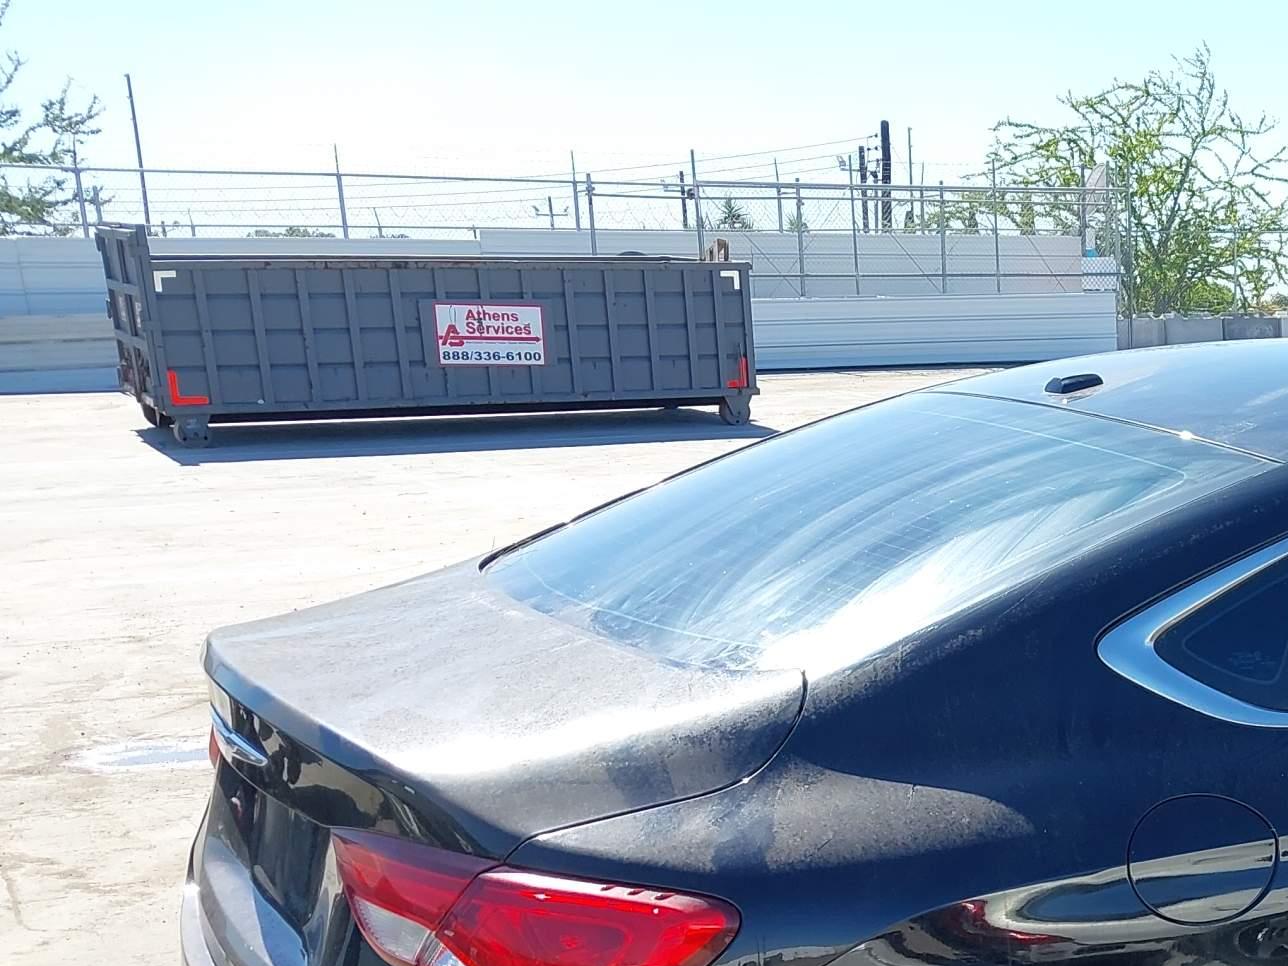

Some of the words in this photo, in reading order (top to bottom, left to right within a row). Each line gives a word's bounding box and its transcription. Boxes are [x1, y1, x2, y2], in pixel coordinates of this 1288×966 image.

[466, 309, 519, 322] Athens
[466, 322, 532, 335] Services
[442, 351, 542, 361] 888/336-6100
